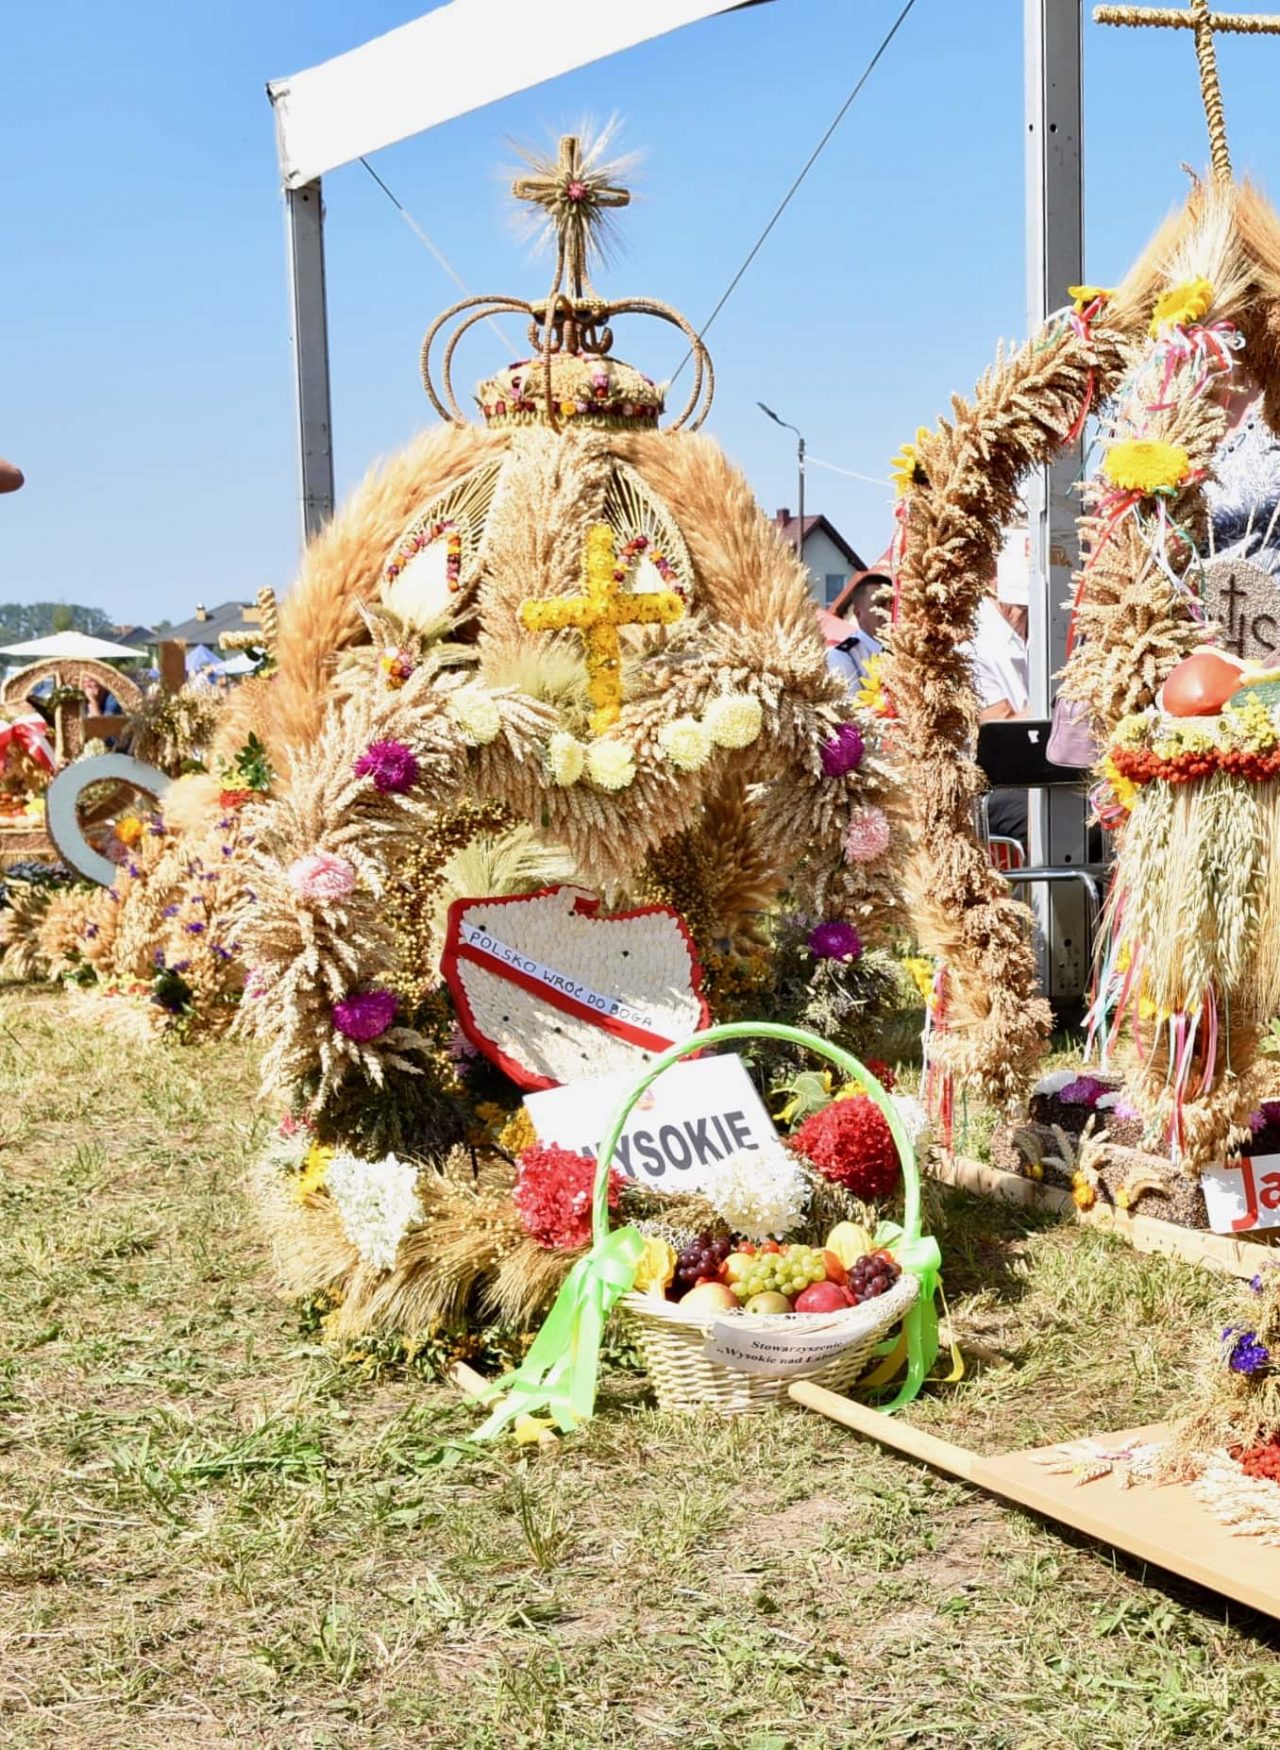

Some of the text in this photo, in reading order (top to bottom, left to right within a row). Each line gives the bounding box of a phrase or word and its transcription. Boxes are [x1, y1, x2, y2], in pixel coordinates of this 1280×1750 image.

[469, 931, 652, 1028] POLSKO WRÓĆ DO BOGA
[780, 1356, 803, 1364] nad
